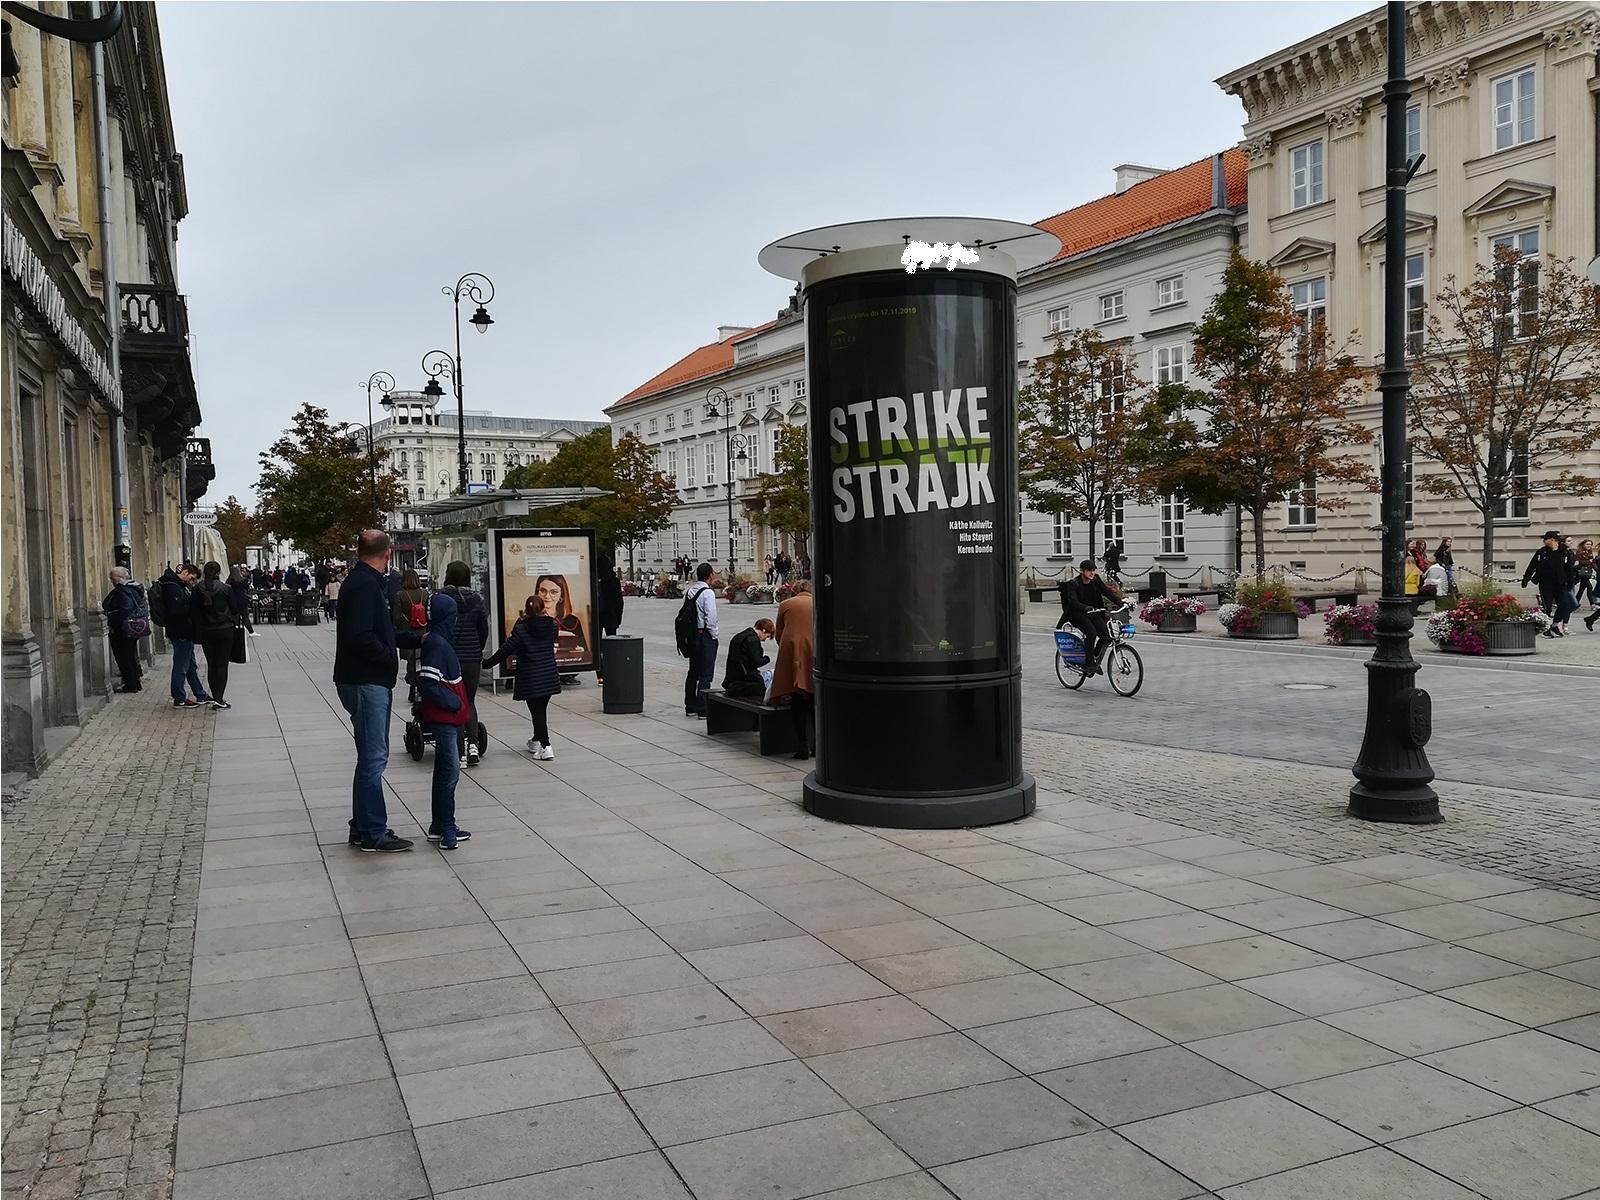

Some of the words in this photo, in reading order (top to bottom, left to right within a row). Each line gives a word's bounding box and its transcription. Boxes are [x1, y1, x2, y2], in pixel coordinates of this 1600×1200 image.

[880, 306, 917, 316] 17.11.2019
[830, 386, 991, 464] STRIKE
[832, 447, 996, 523] STRAJK
[959, 532, 972, 542] Hito
[957, 545, 974, 554] Keren
